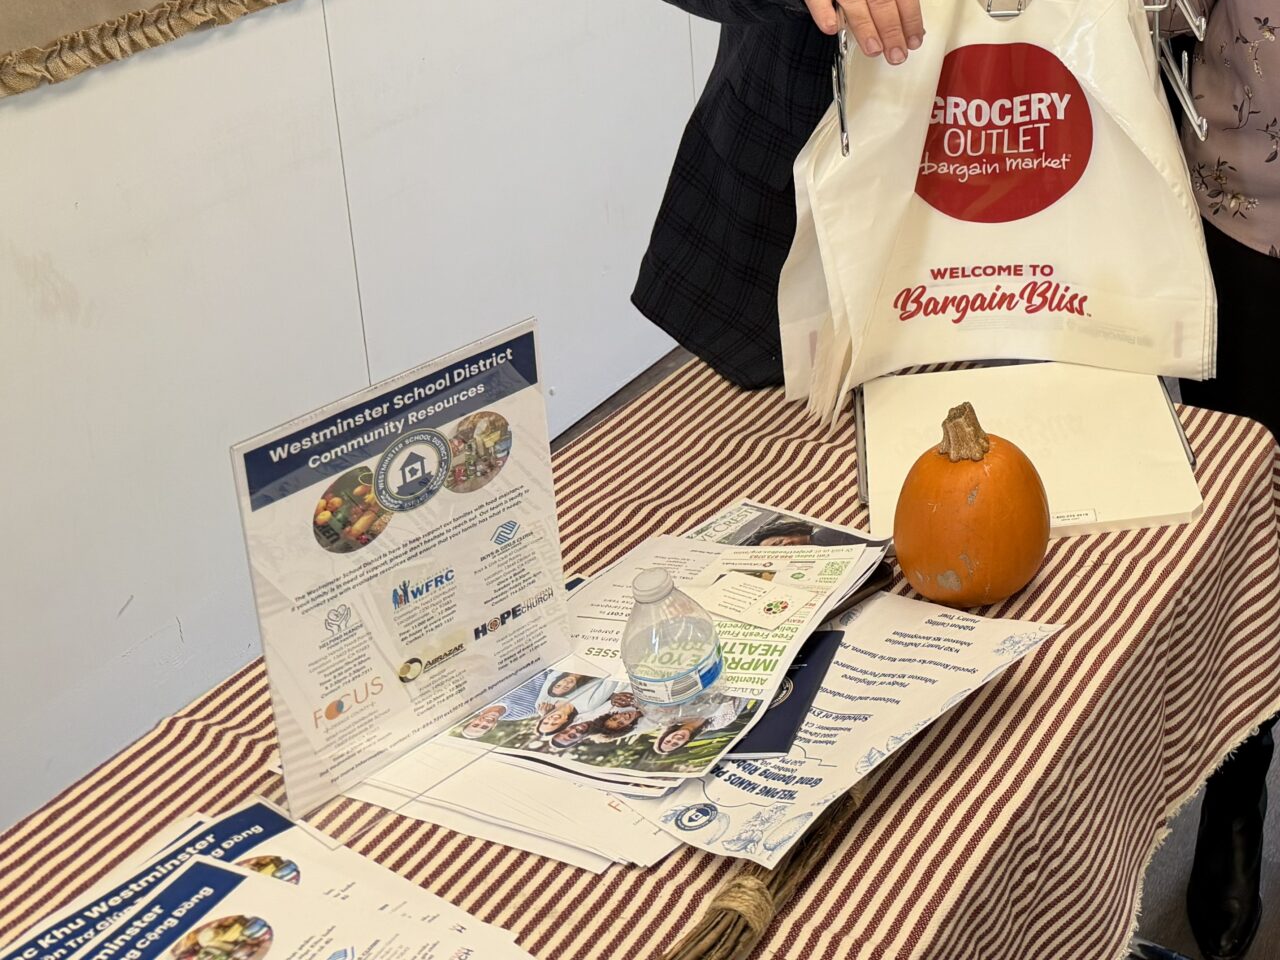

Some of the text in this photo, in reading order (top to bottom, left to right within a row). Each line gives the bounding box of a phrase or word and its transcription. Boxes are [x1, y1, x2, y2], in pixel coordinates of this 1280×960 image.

[929, 92, 1071, 127] GROCERY
[943, 122, 1051, 158] OUTLET
[920, 153, 1069, 183] bargain market
[929, 264, 1054, 281] WELCOME TO
[893, 279, 1087, 324] Bargain Bliss
[269, 347, 513, 464] Westminster School District
[307, 383, 486, 470] Community Resources
[378, 434, 448, 490] WESTMINSTER SCHOOL DISTRICT
[305, 574, 342, 597] Westminster
[341, 563, 363, 579] School
[361, 553, 382, 568] District
[452, 508, 474, 523] families
[484, 496, 498, 507] food
[410, 569, 455, 599] WFRC
[474, 604, 522, 640] HOPE
[520, 591, 554, 614] CHURCH
[718, 630, 794, 641] Free Fresh Fruit
[423, 643, 465, 670] ABRAZAR
[313, 676, 384, 729] FOCUS
[832, 713, 869, 722] Schedule
[723, 771, 761, 793] HANDS
[759, 768, 797, 786] Opening
[795, 776, 823, 788] Grand
[222, 824, 264, 851] Đồng
[37, 831, 216, 949] Khu Westminster
[173, 885, 215, 919] Đồng
